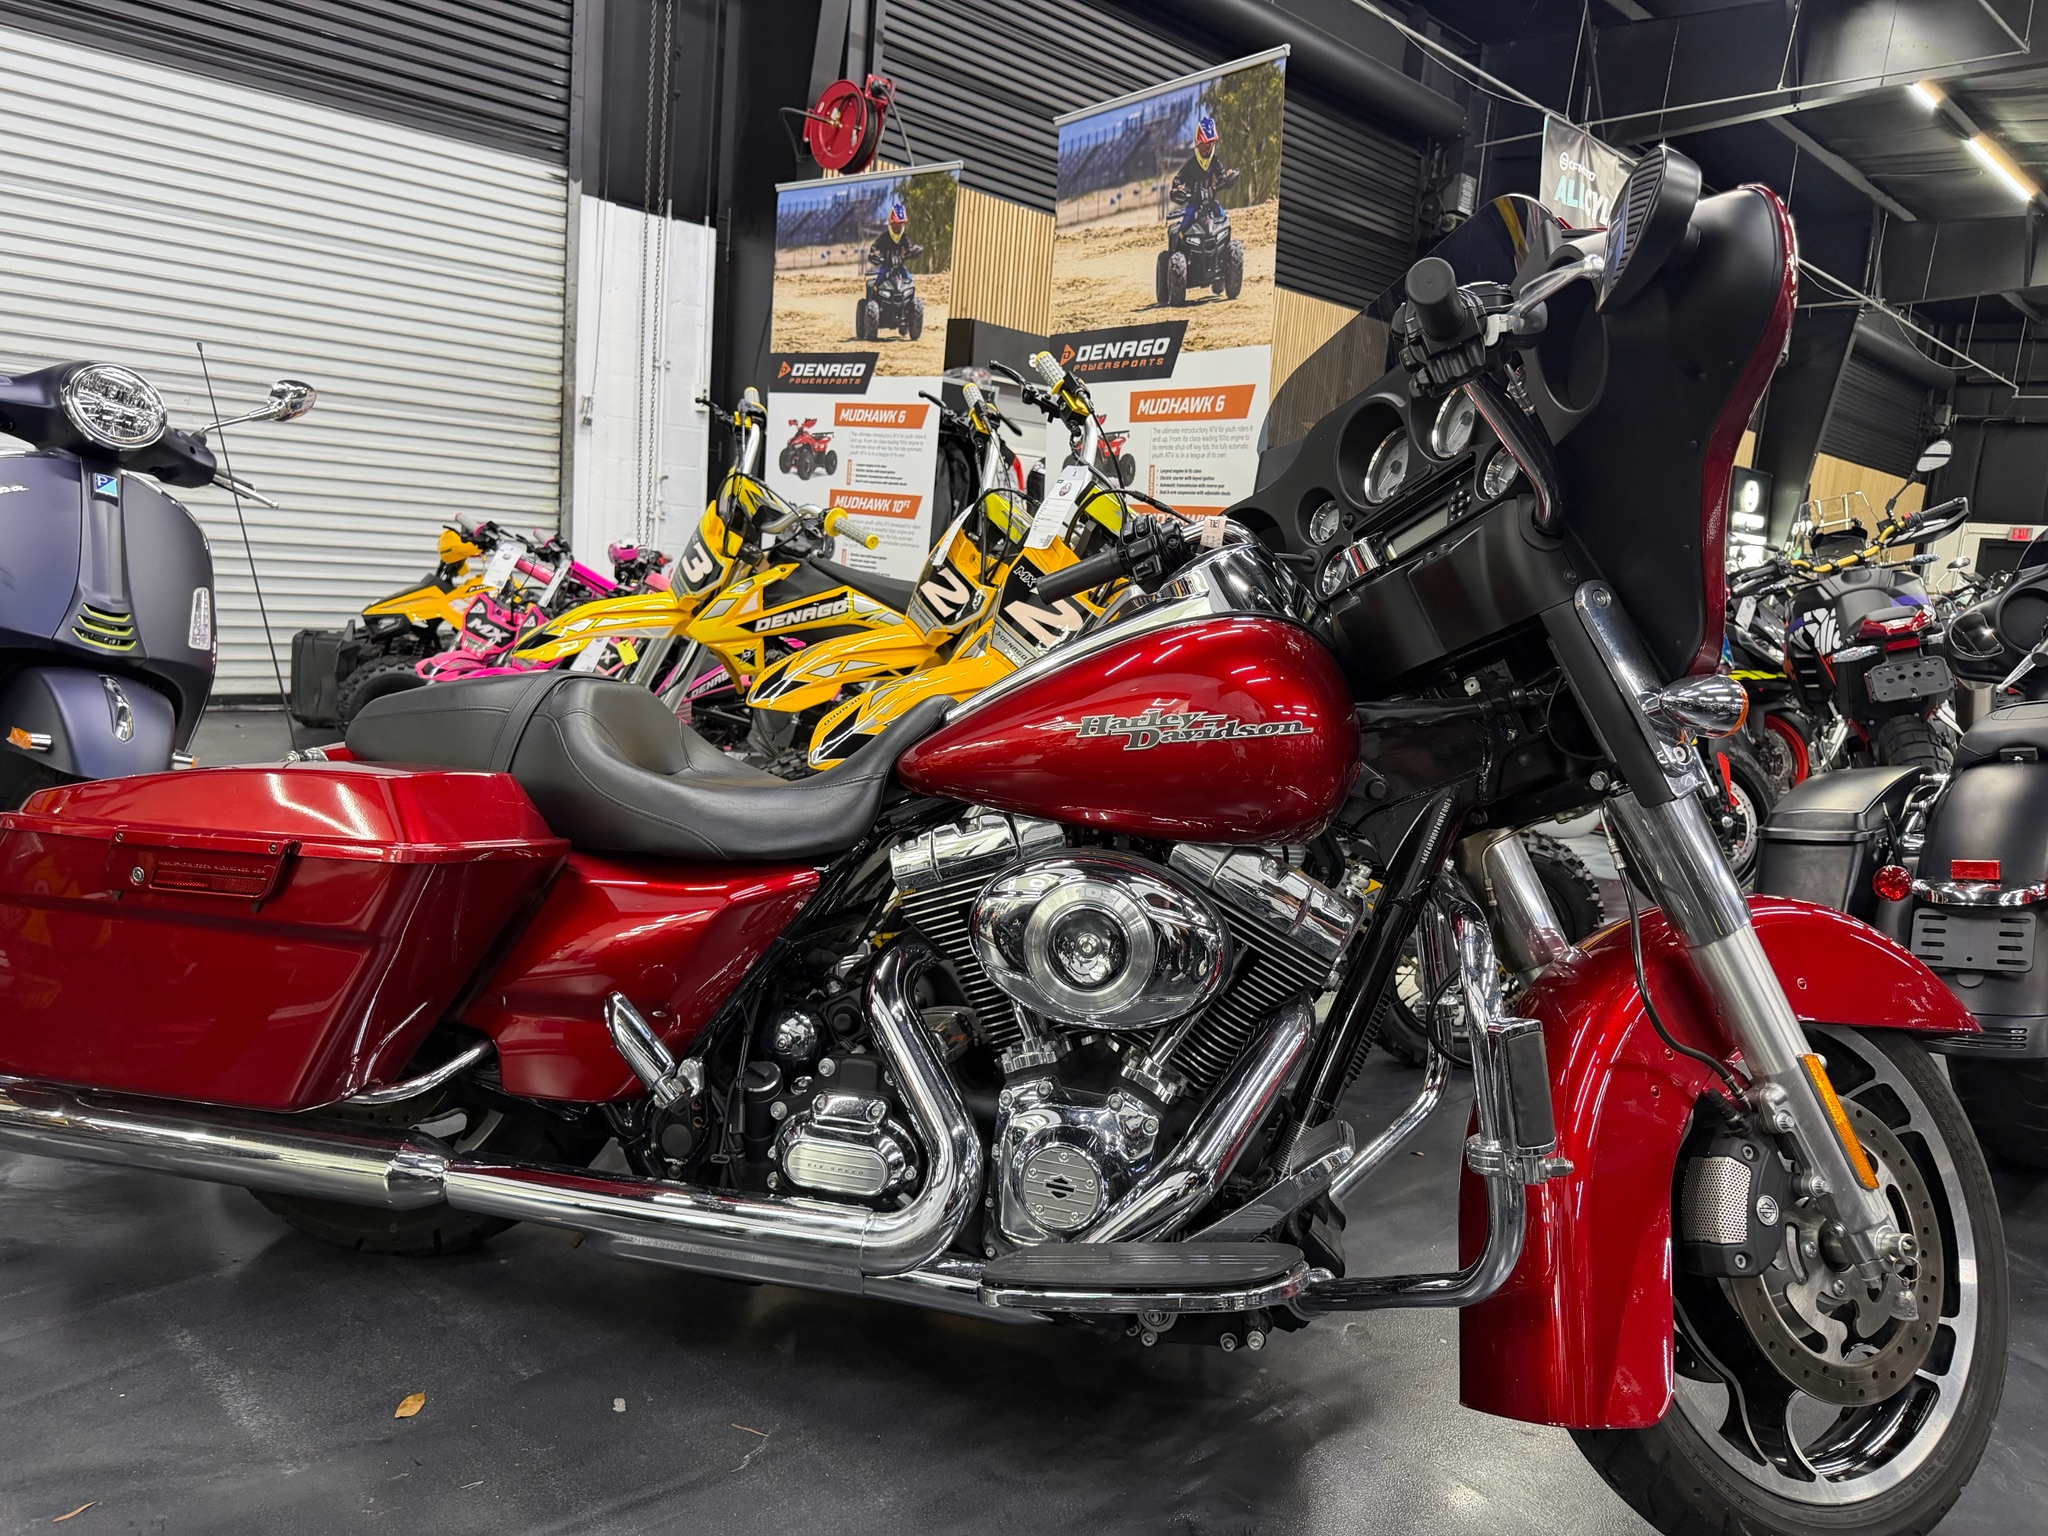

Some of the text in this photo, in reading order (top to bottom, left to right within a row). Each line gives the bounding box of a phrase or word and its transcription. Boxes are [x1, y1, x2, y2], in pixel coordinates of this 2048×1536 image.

[1076, 338, 1171, 362] DENAGO
[791, 363, 866, 376] DENAGO
[1072, 358, 1164, 372] POWERSPORTS
[839, 408, 906, 424] MUDHAWK 6
[1136, 395, 1226, 416] MUDHAWK 6
[834, 495, 892, 512] MUDHAWK
[2012, 528, 2030, 540] EXIT
[682, 542, 714, 583] 3
[1013, 566, 1036, 588] MX
[920, 566, 970, 618] 2
[754, 600, 848, 632] DENAGO
[466, 617, 512, 644] MX
[1000, 635, 1028, 660] DENAGO
[690, 670, 731, 698] DENAG
[1076, 710, 1212, 738] Harley
[1123, 720, 1314, 750] Davidson
